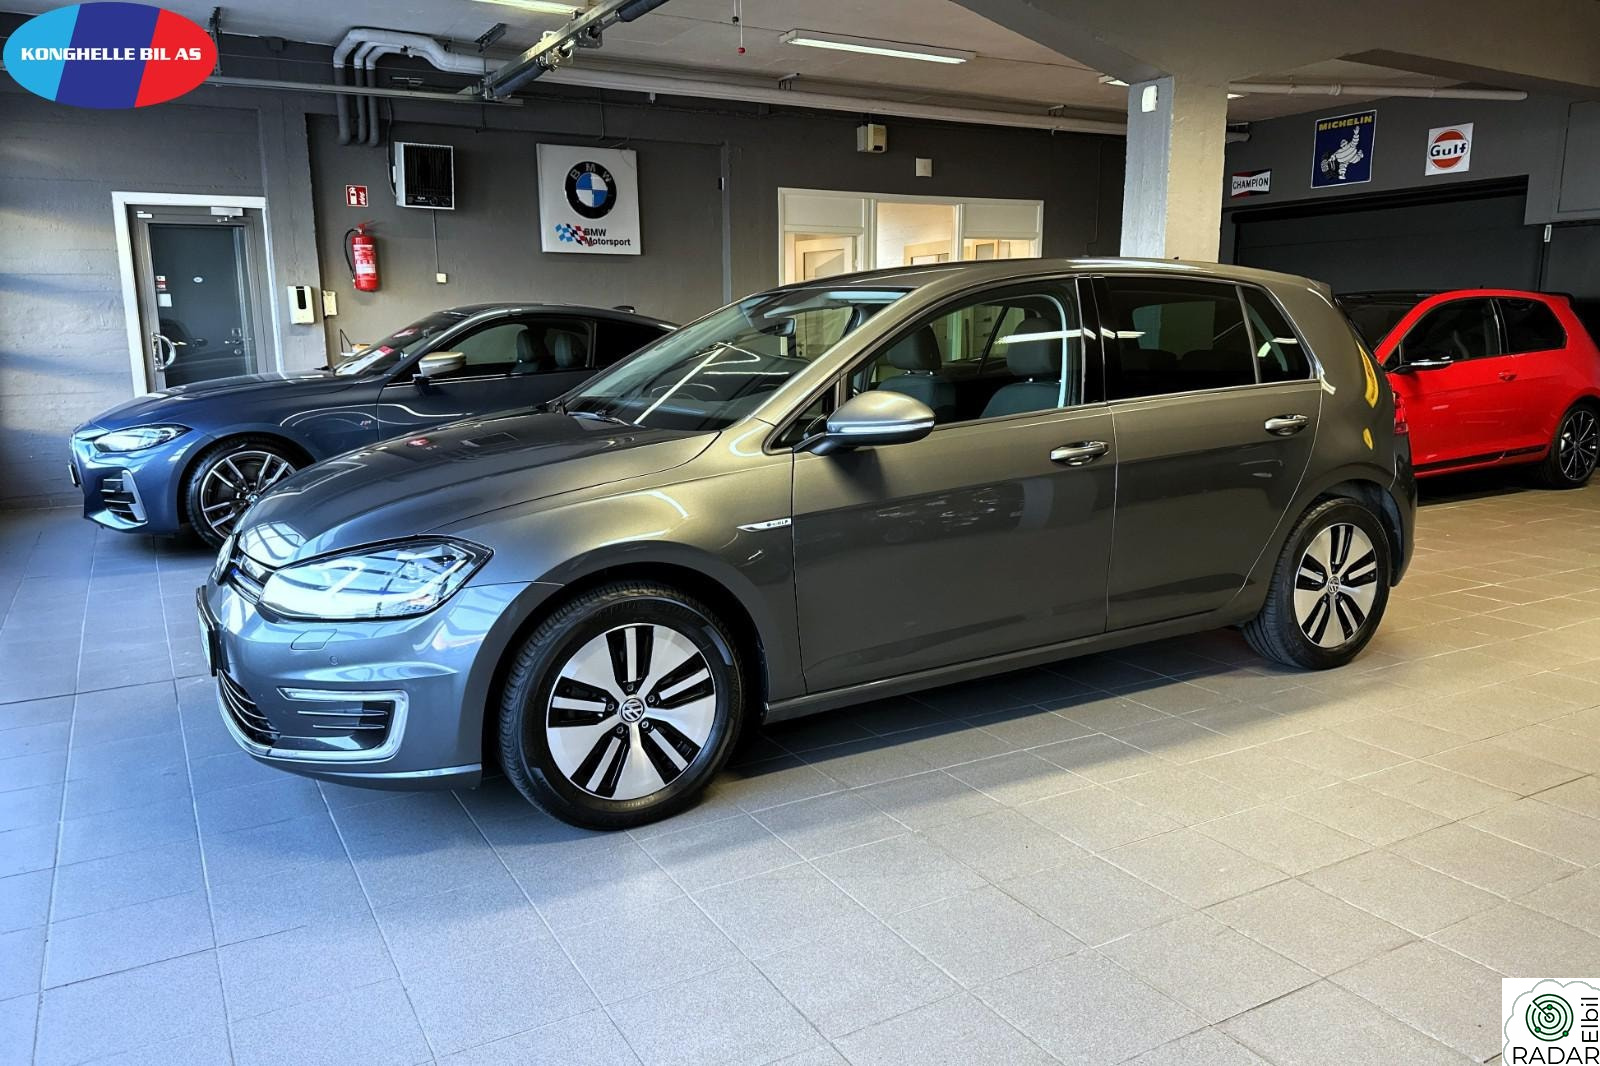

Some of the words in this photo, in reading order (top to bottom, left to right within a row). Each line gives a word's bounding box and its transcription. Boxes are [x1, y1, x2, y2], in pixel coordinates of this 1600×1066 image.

[1318, 115, 1373, 131] MICHELIN
[1430, 142, 1467, 157] Gulf
[569, 162, 612, 182] BMW
[1232, 177, 1269, 190] CHAMPION
[584, 228, 607, 237] BMW
[584, 236, 632, 247] Motorsport
